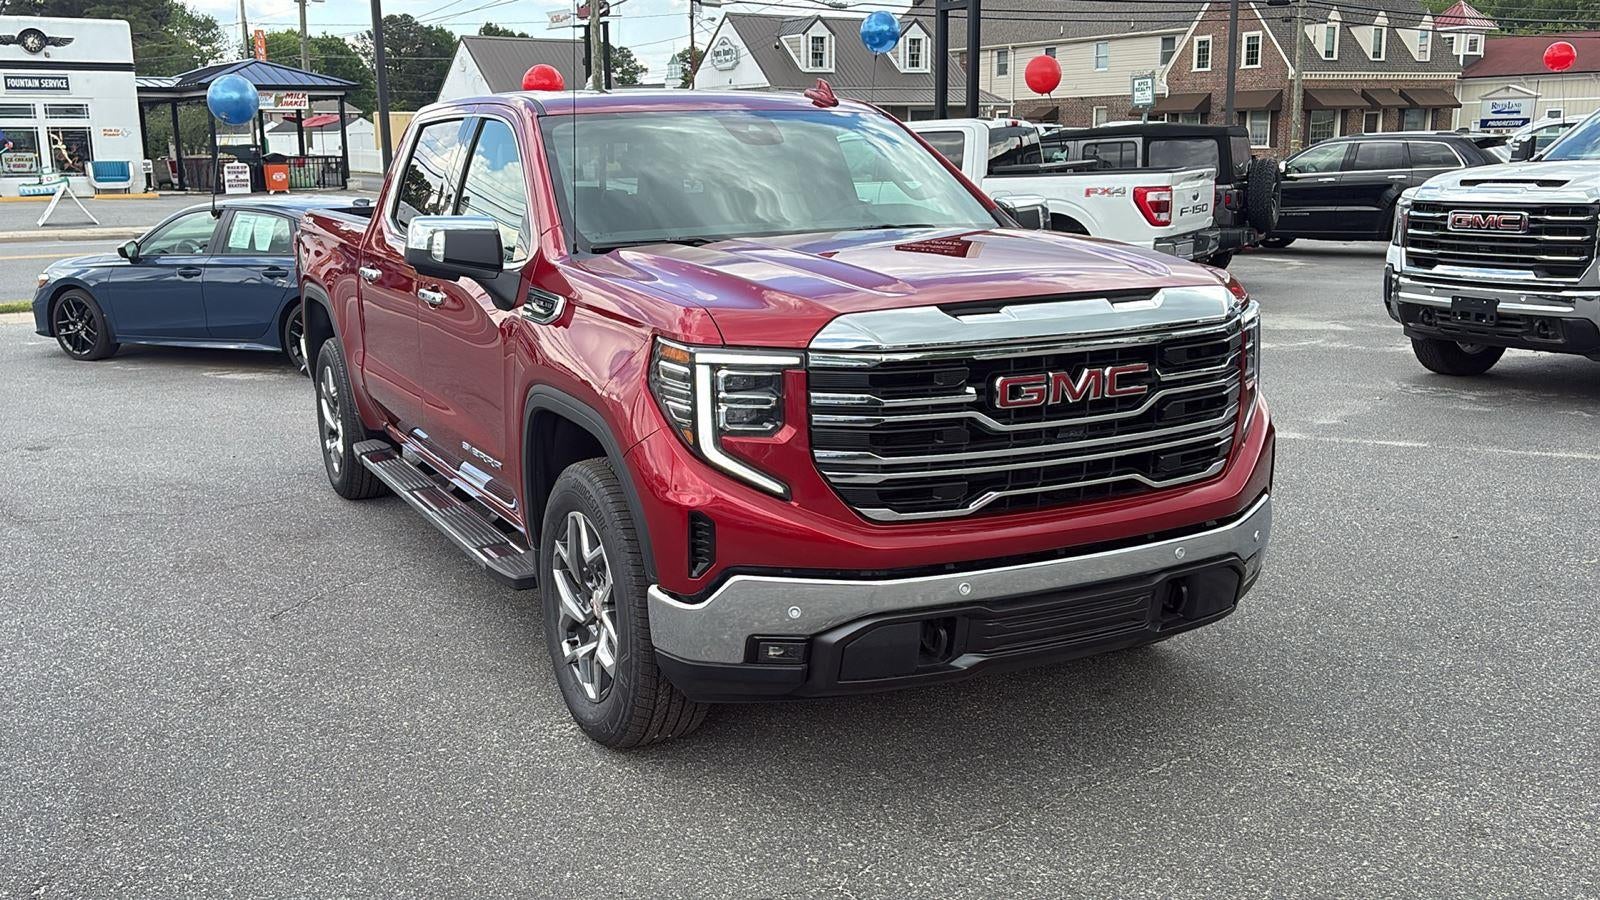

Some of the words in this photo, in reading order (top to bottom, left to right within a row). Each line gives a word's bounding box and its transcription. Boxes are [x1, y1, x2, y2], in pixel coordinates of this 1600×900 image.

[7, 78, 40, 87] FOUNTAIN
[40, 79, 68, 88] SERVICE
[1084, 187, 1127, 198] FX4
[1180, 203, 1209, 217] F-150
[1452, 214, 1521, 230] GMC
[995, 363, 1149, 409] GMC
